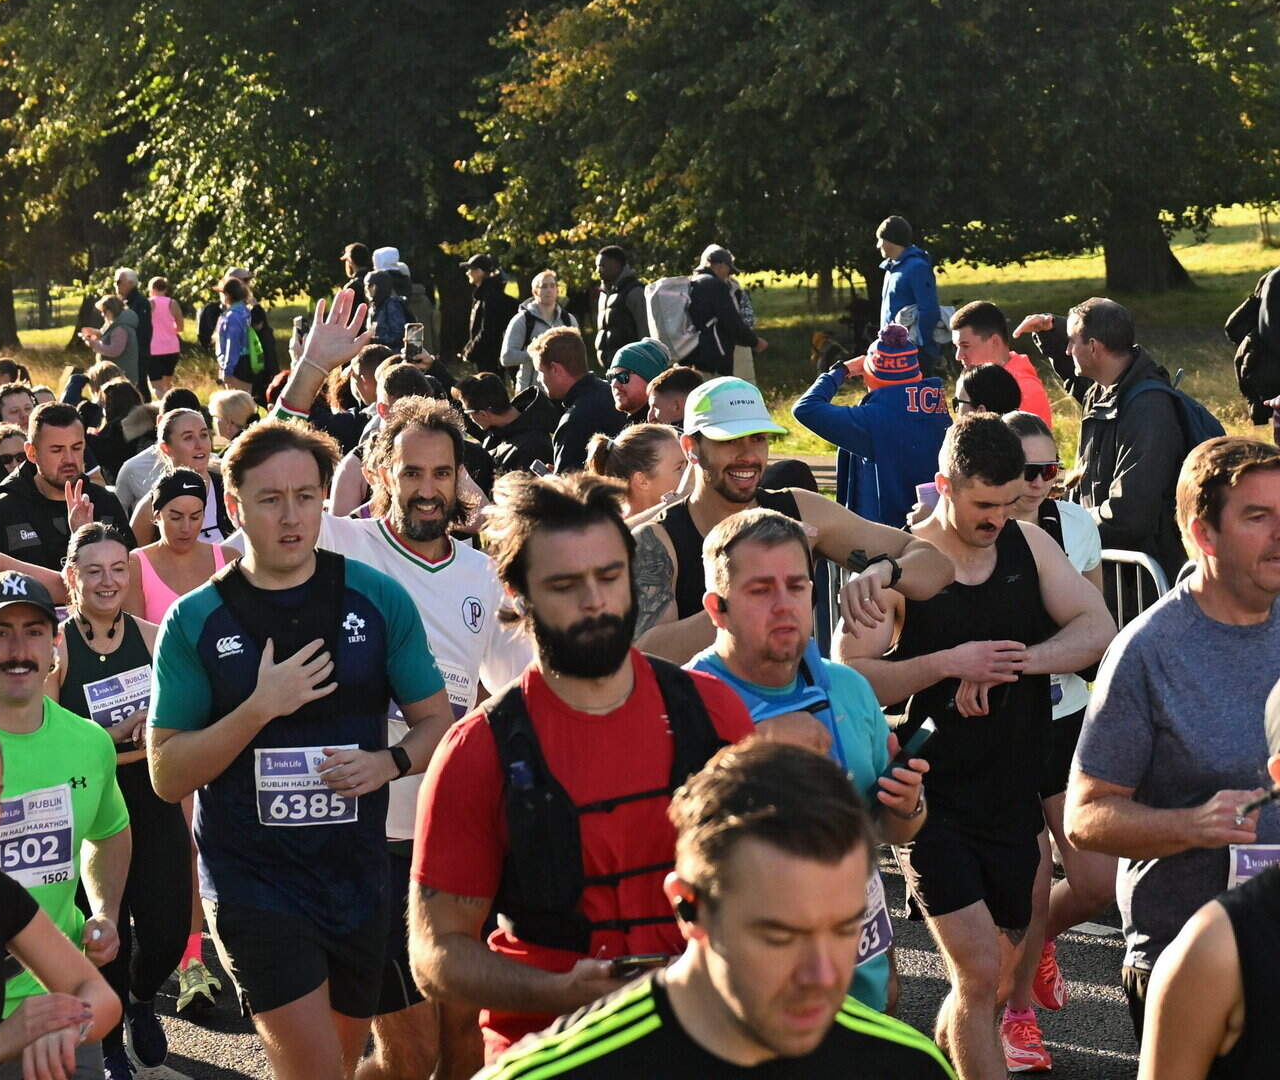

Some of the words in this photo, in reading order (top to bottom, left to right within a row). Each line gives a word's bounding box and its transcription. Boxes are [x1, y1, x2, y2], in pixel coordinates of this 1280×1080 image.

[1, 575, 28, 596] NY
[348, 635, 366, 644] IRFU
[125, 673, 149, 685] DUBLIN
[93, 701, 114, 710] DUBLIN
[114, 696, 129, 704] HALF
[449, 694, 468, 703] THON
[273, 760, 289, 768] Irish
[289, 759, 302, 768] Life
[261, 780, 289, 788] DUBLIN
[291, 780, 311, 788] HALF
[28, 797, 63, 810] DUBLIN
[270, 793, 346, 820] 6385
[9, 826, 26, 837] HALF
[26, 819, 69, 832] MARATHON
[42, 870, 69, 885] 1502
